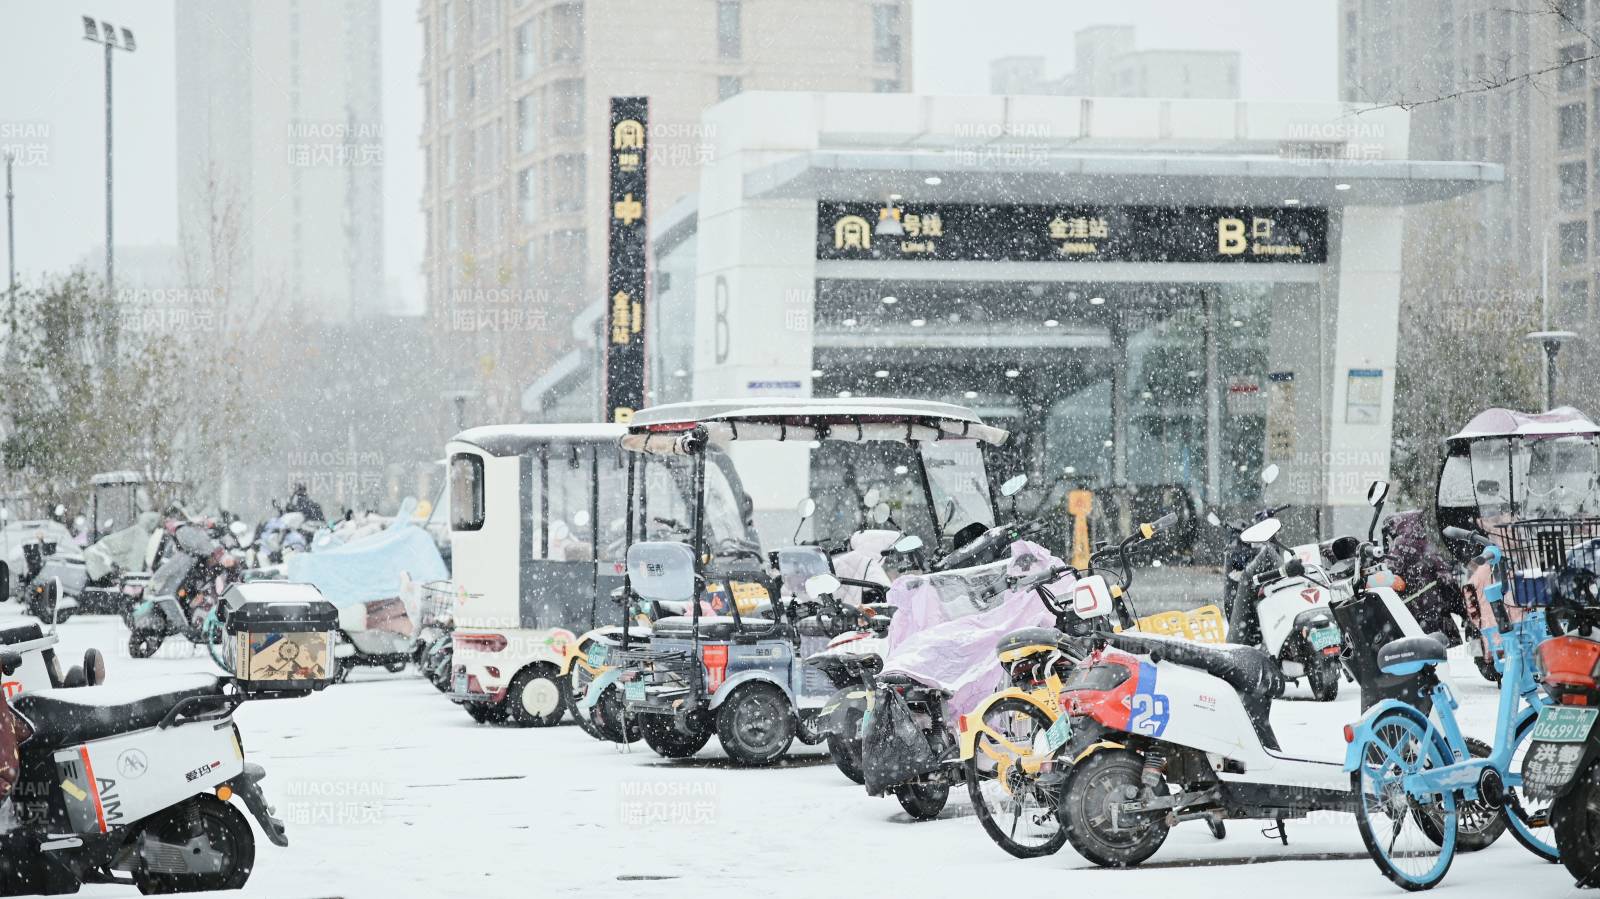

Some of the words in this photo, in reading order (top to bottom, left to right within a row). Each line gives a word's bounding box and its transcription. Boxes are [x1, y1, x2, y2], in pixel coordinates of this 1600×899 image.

[1217, 217, 1247, 254] B
[1252, 217, 1272, 238] 口
[715, 274, 730, 365] B
[1533, 743, 1581, 763] 洪都
[185, 763, 212, 783] 爱玛
[1527, 760, 1576, 775] 电动车
